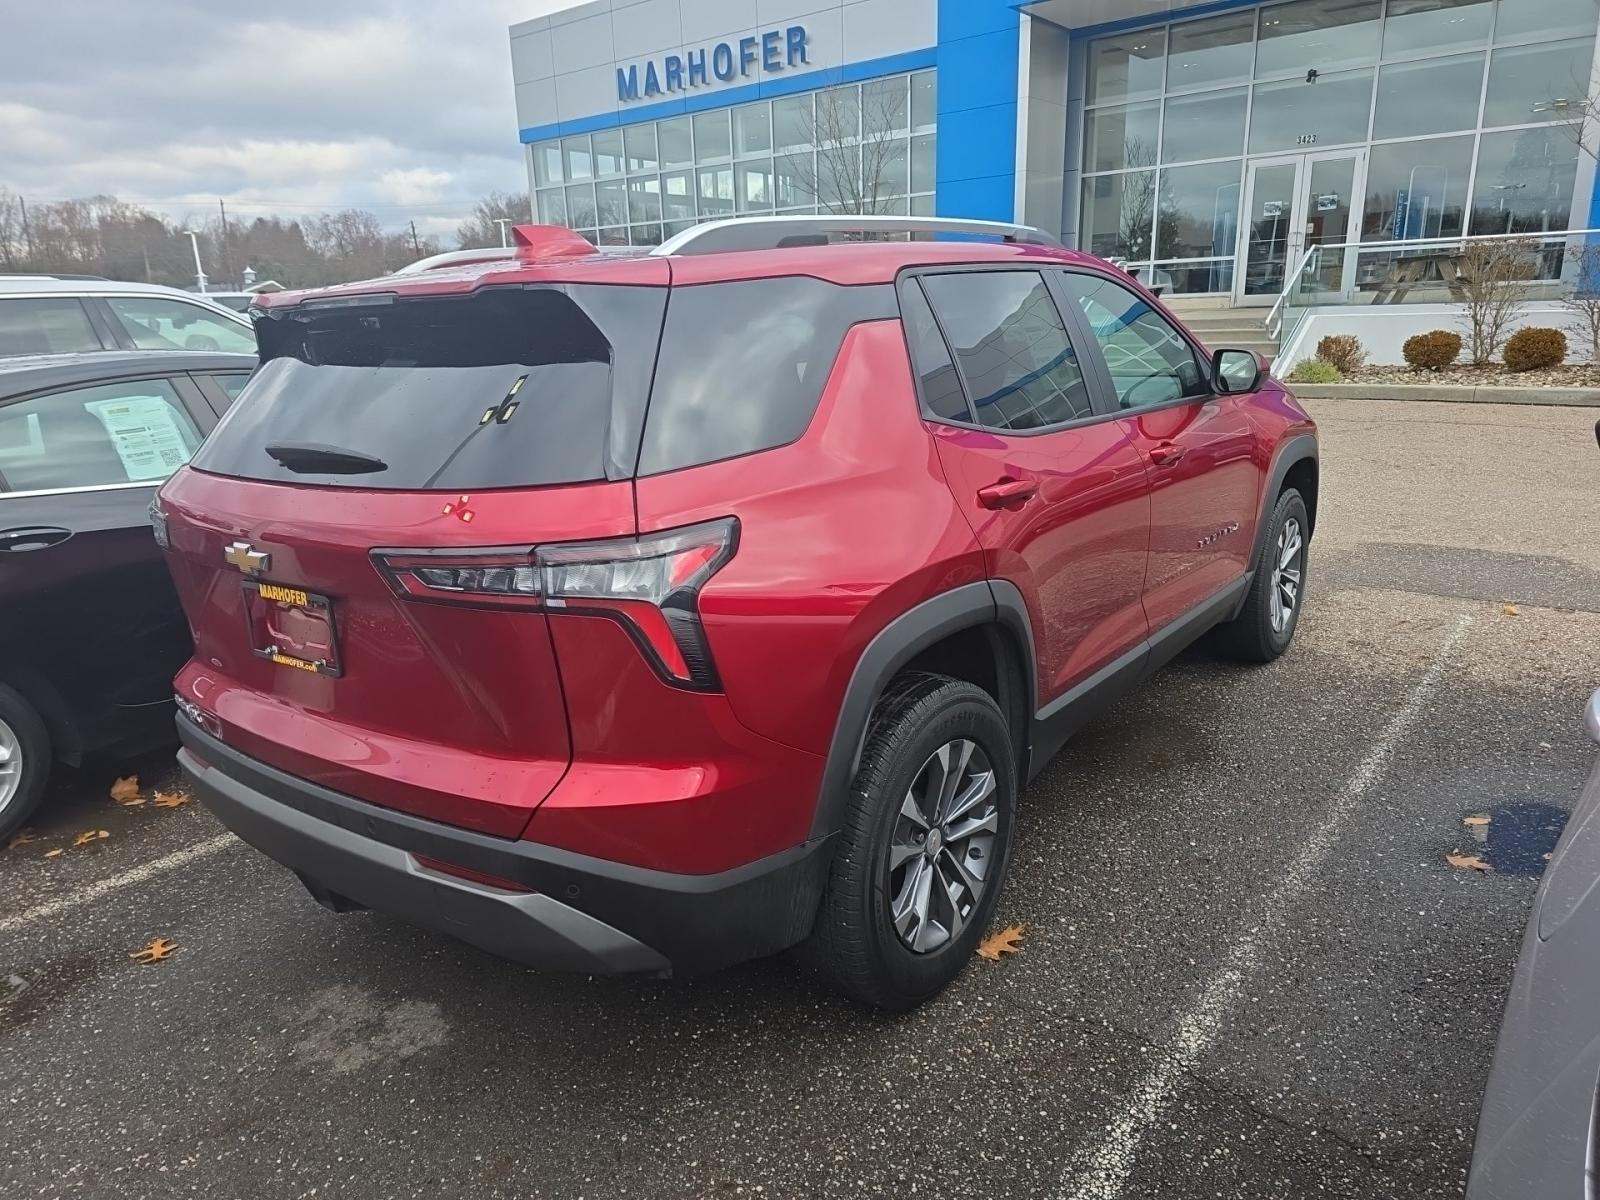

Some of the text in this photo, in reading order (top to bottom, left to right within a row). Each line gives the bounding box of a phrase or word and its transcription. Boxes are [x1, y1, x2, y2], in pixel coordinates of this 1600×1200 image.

[616, 25, 807, 100] MARHOFER
[1296, 134, 1317, 144] 3423
[259, 584, 308, 606] MARHOFER
[272, 654, 318, 672] MARHOFER.com
